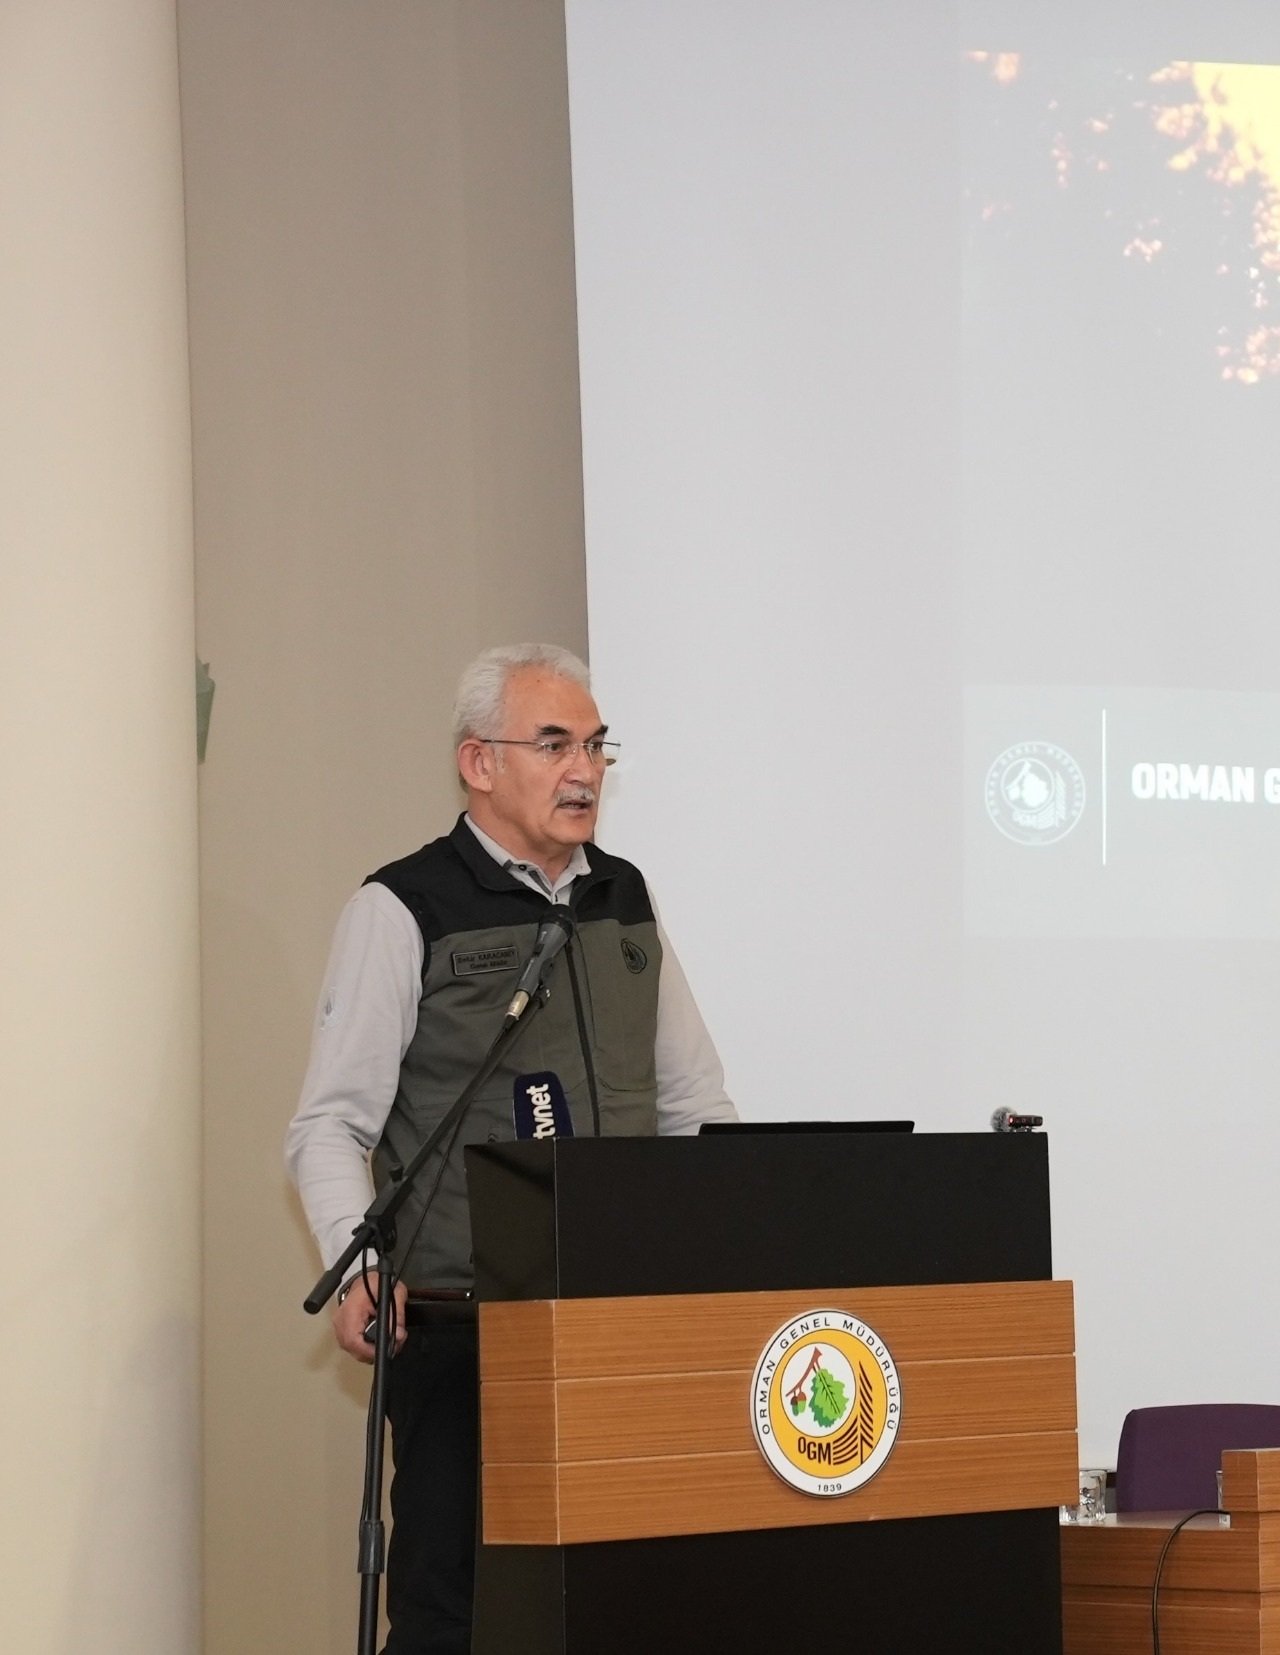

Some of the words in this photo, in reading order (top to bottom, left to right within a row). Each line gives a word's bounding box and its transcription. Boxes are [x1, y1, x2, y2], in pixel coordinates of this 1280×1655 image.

[1131, 763, 1255, 803] ORMAN
[526, 1083, 556, 1139] tvnet
[760, 1359, 776, 1435] ORMAN
[779, 1317, 831, 1350] GENEL
[842, 1319, 899, 1430] MÜDÜRLÜĞÜ
[797, 1436, 832, 1466] OGM
[816, 1483, 843, 1493] 1839
